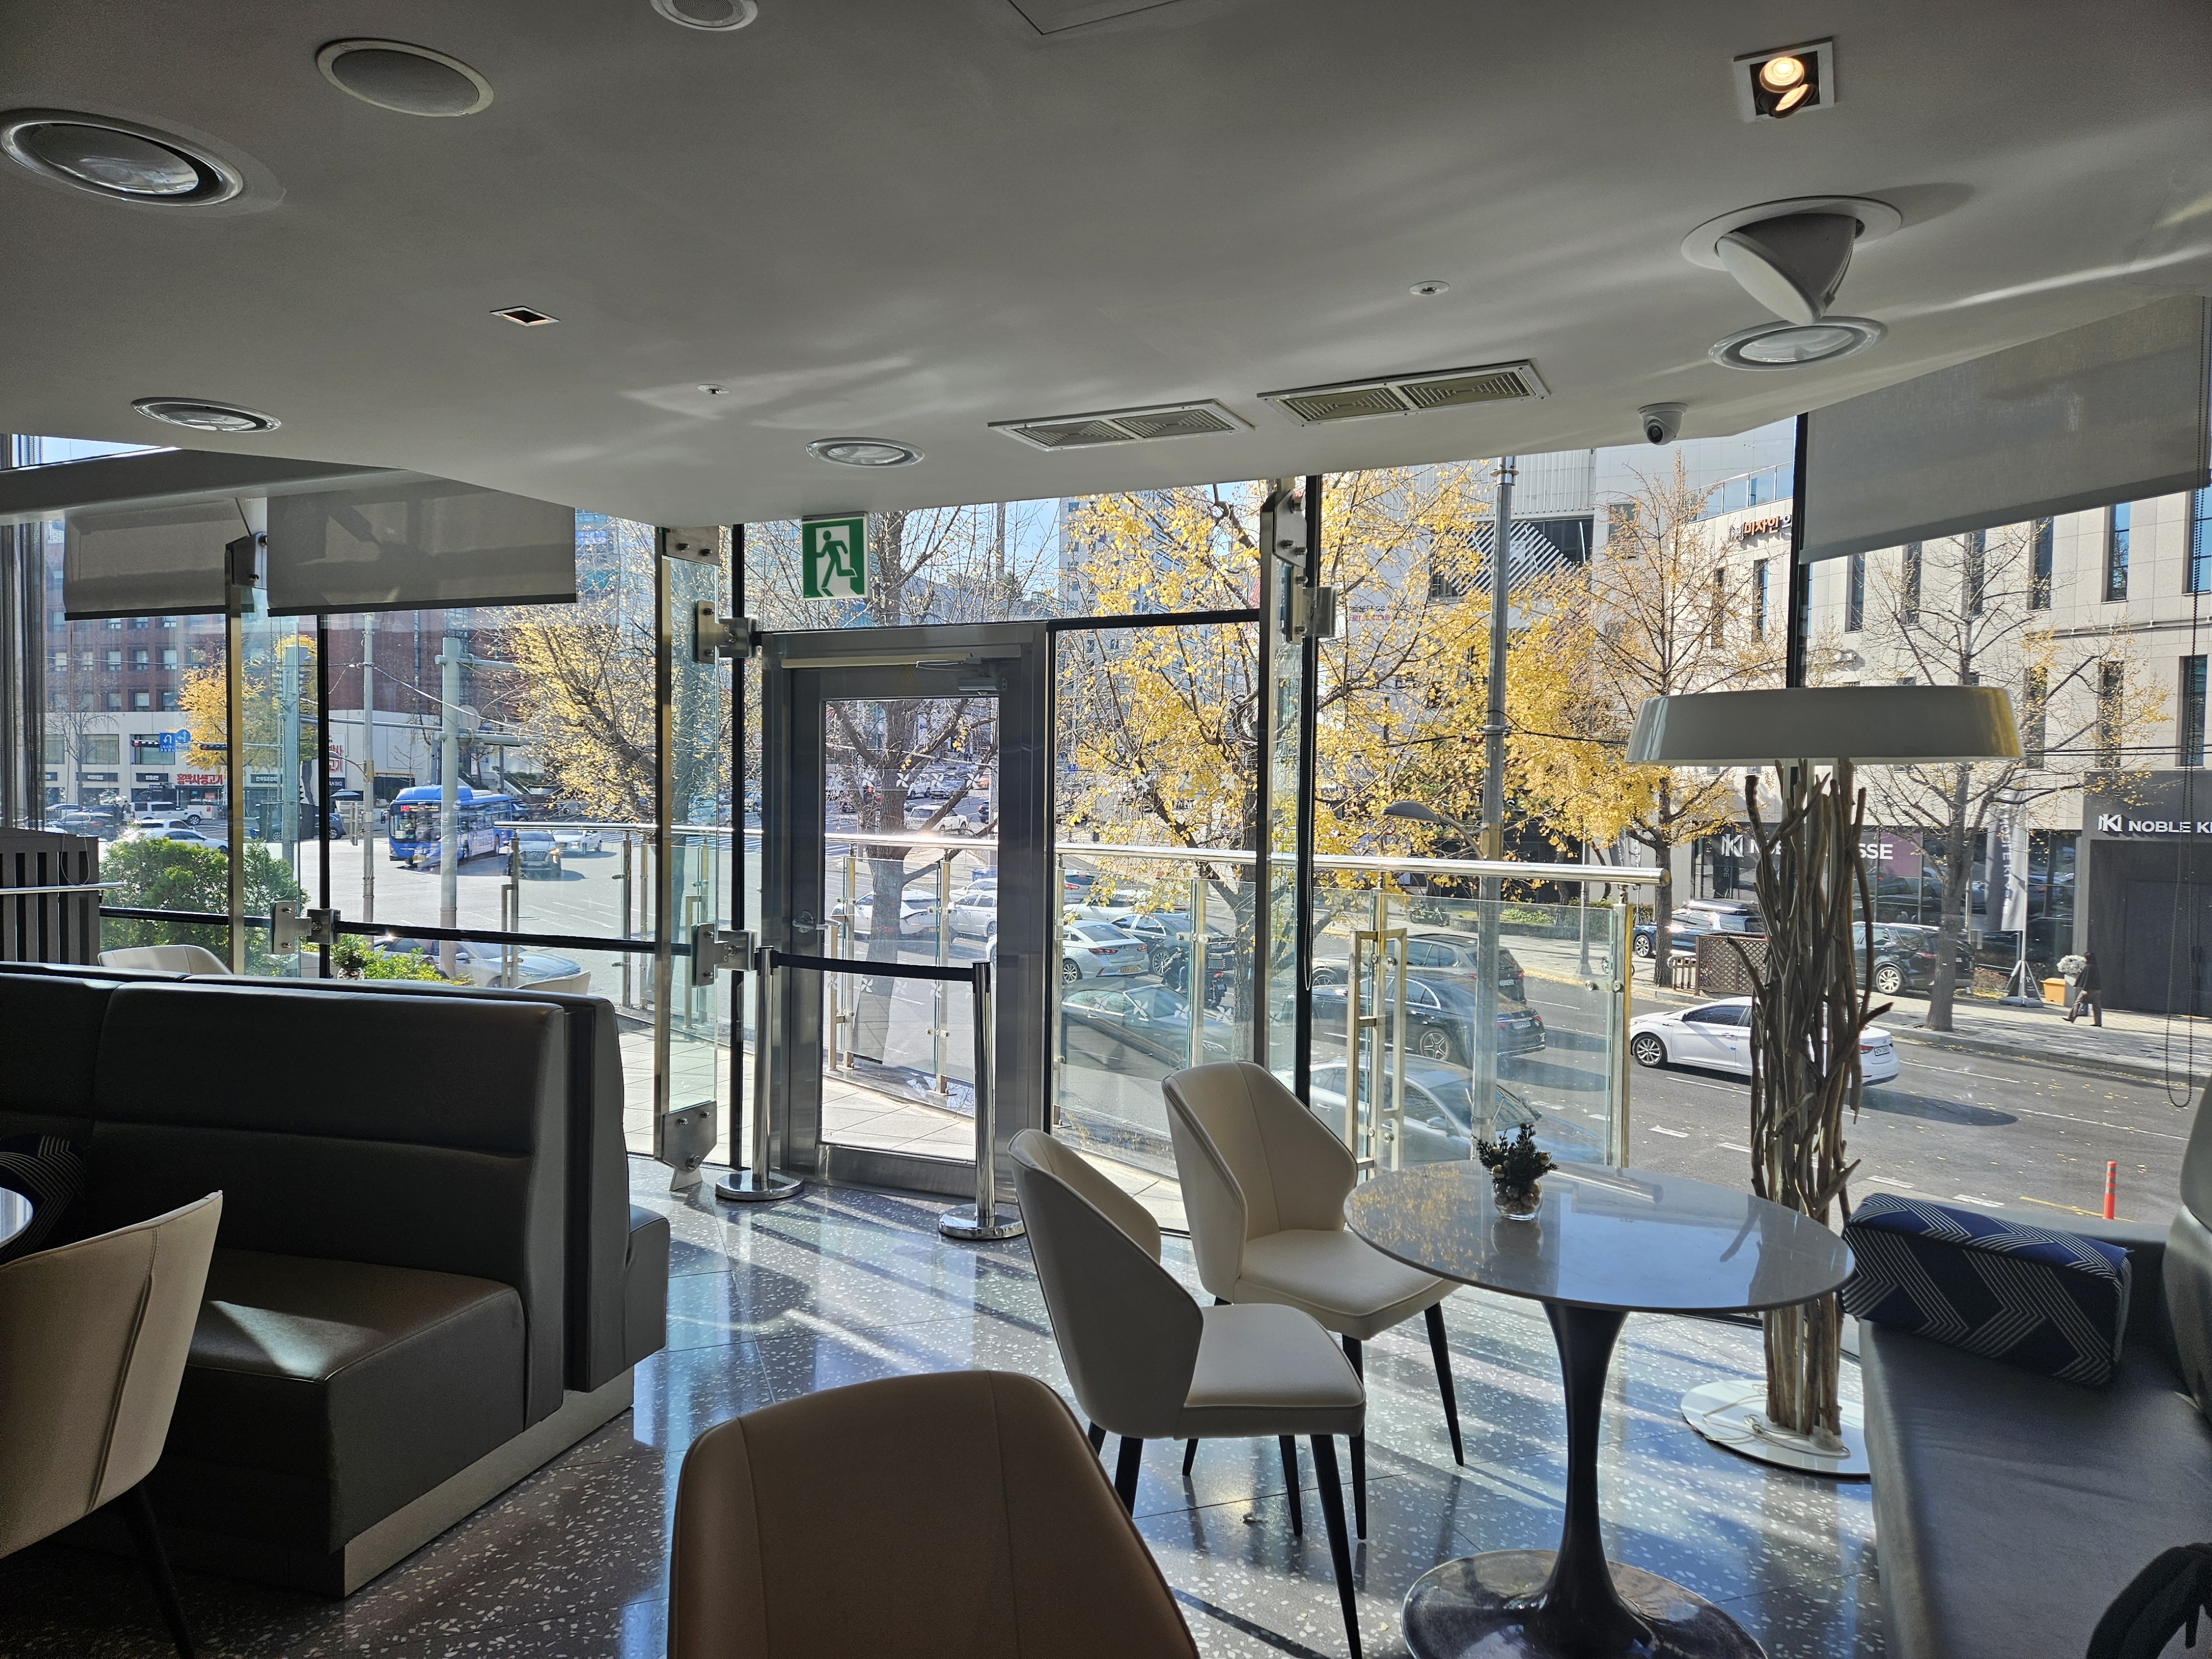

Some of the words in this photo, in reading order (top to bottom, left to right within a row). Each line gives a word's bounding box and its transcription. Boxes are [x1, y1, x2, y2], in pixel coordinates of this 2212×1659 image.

[1743, 515, 1780, 536] 미자인
[176, 774, 223, 785] 홍박사생고기
[2128, 821, 2191, 833] NOBLE
